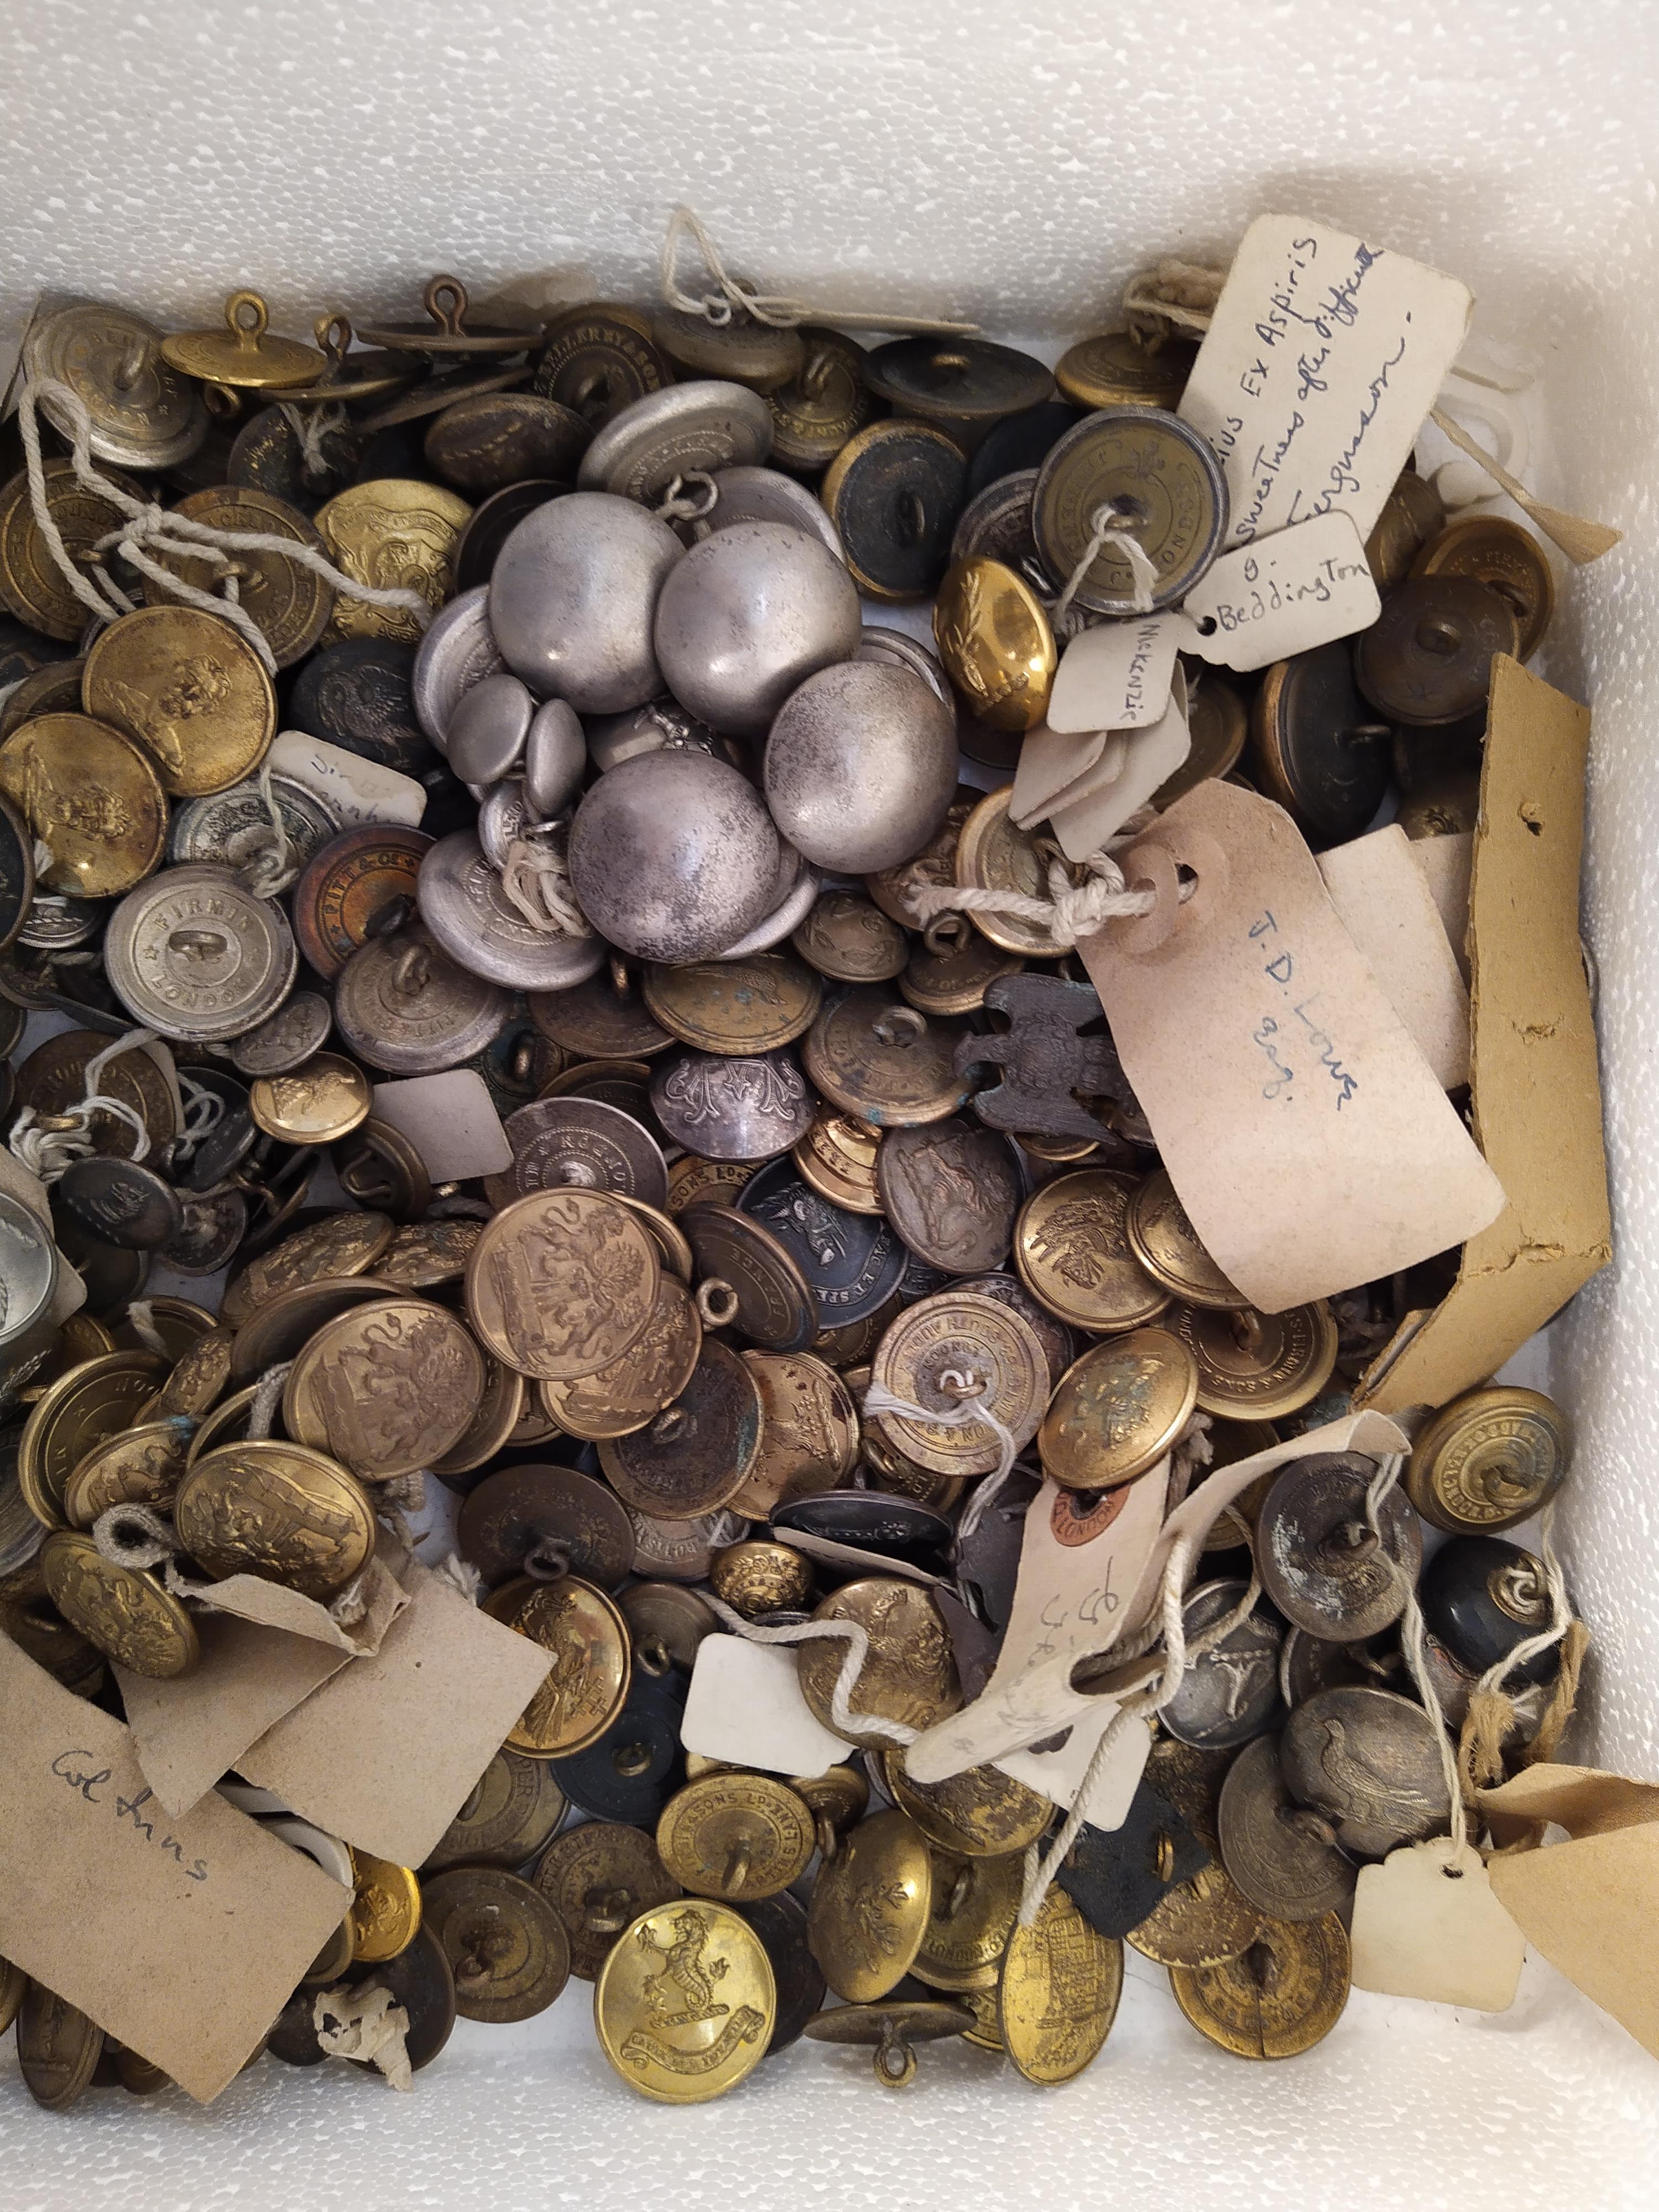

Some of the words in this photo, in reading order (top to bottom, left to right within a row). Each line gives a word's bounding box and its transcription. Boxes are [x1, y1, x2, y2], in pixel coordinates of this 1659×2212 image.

[1297, 347, 1331, 401] after
[154, 898, 248, 931] FIRMIN
[852, 1272, 877, 1297] ET
